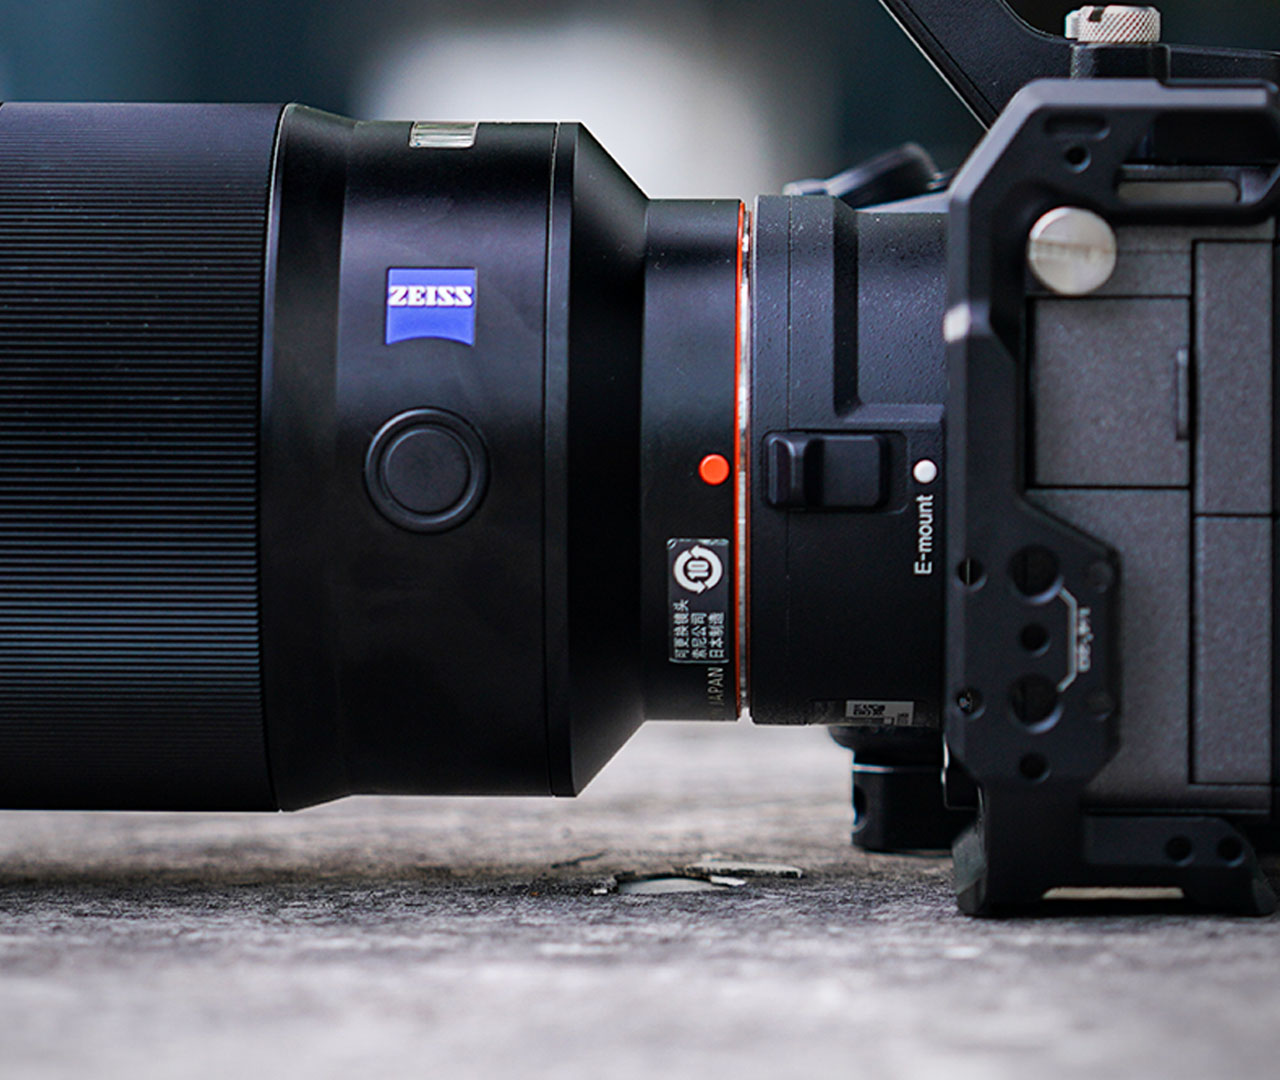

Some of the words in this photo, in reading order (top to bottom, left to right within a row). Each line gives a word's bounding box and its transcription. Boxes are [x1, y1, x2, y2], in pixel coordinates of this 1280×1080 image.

[388, 286, 473, 308] ZEISS
[914, 495, 933, 575] E-mount
[688, 562, 708, 581] 10
[673, 599, 689, 659] 可更换镜头
[691, 612, 707, 659] 索尼公司
[708, 612, 724, 659] 日本制造
[708, 667, 723, 707] JAPAN
